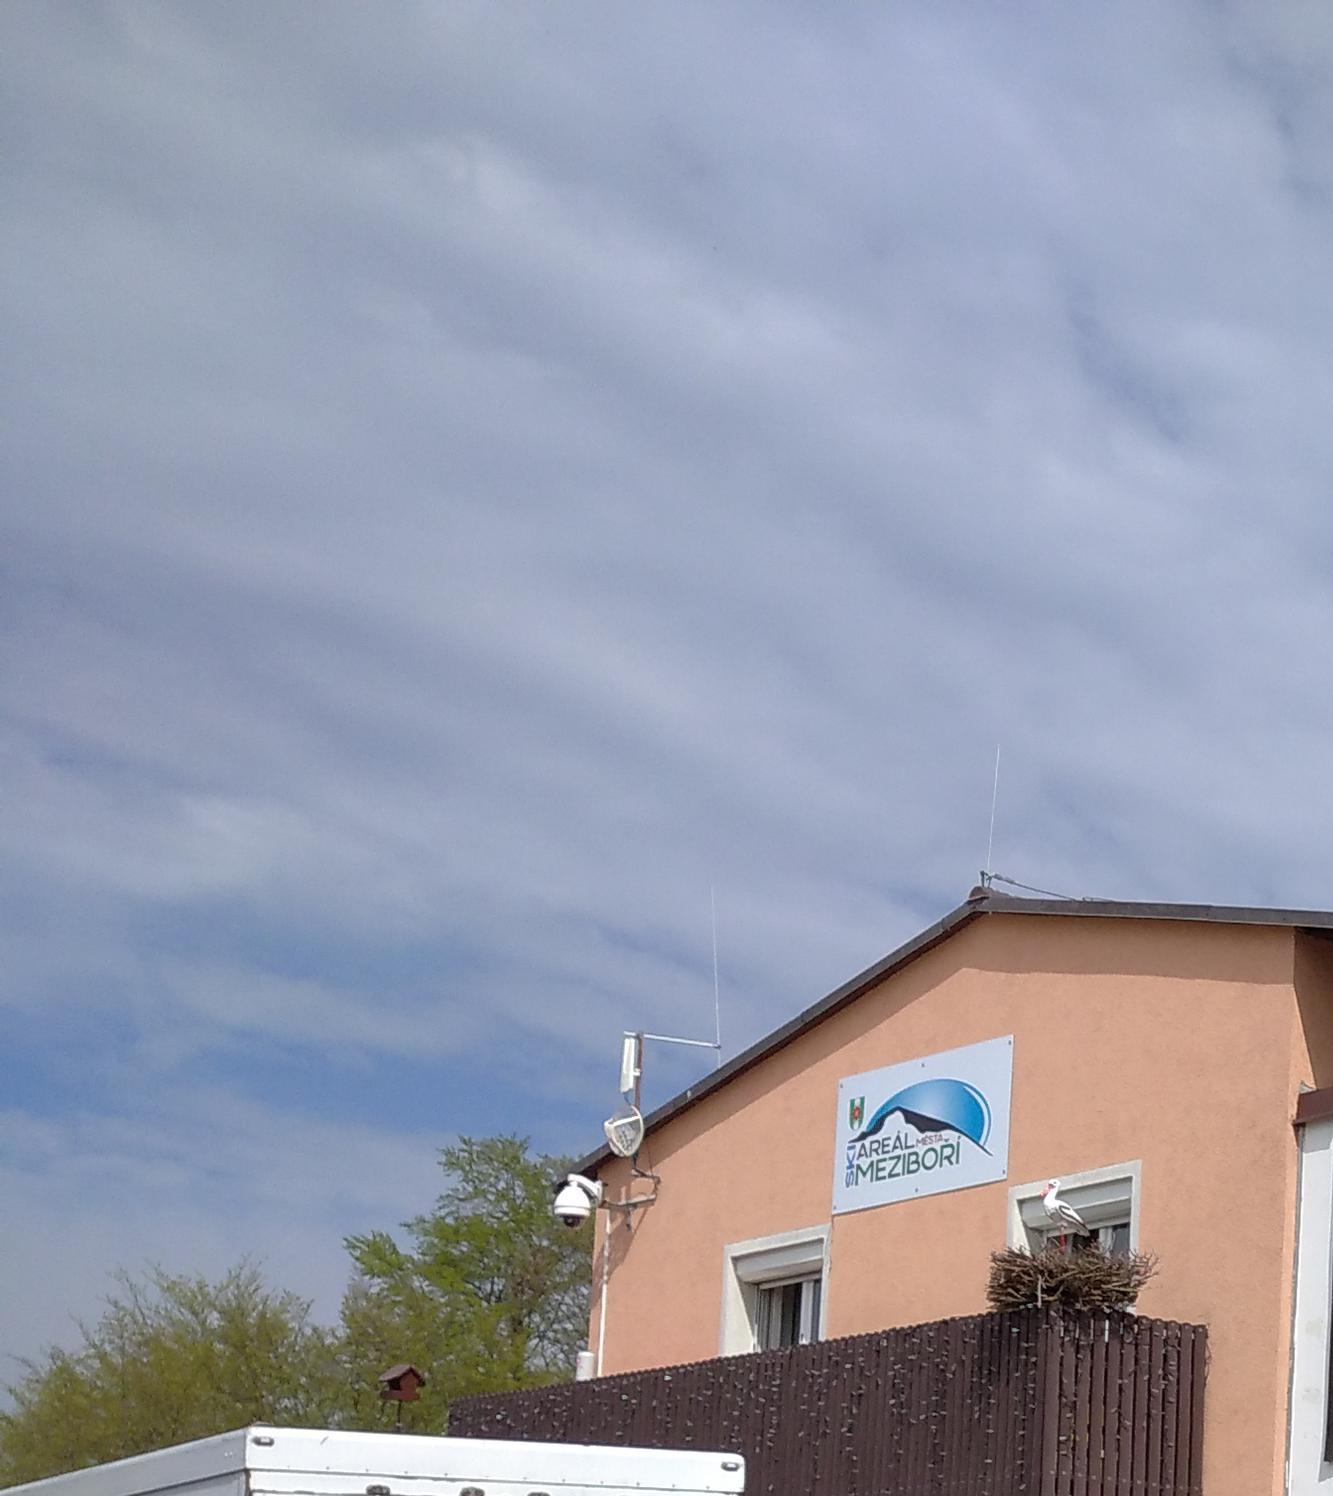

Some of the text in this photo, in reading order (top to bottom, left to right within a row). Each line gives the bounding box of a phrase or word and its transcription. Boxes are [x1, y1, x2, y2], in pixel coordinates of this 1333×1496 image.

[855, 1136, 962, 1186] MEZIBOŘÍ
[856, 1130, 944, 1160] AREÁL MĚSTA
